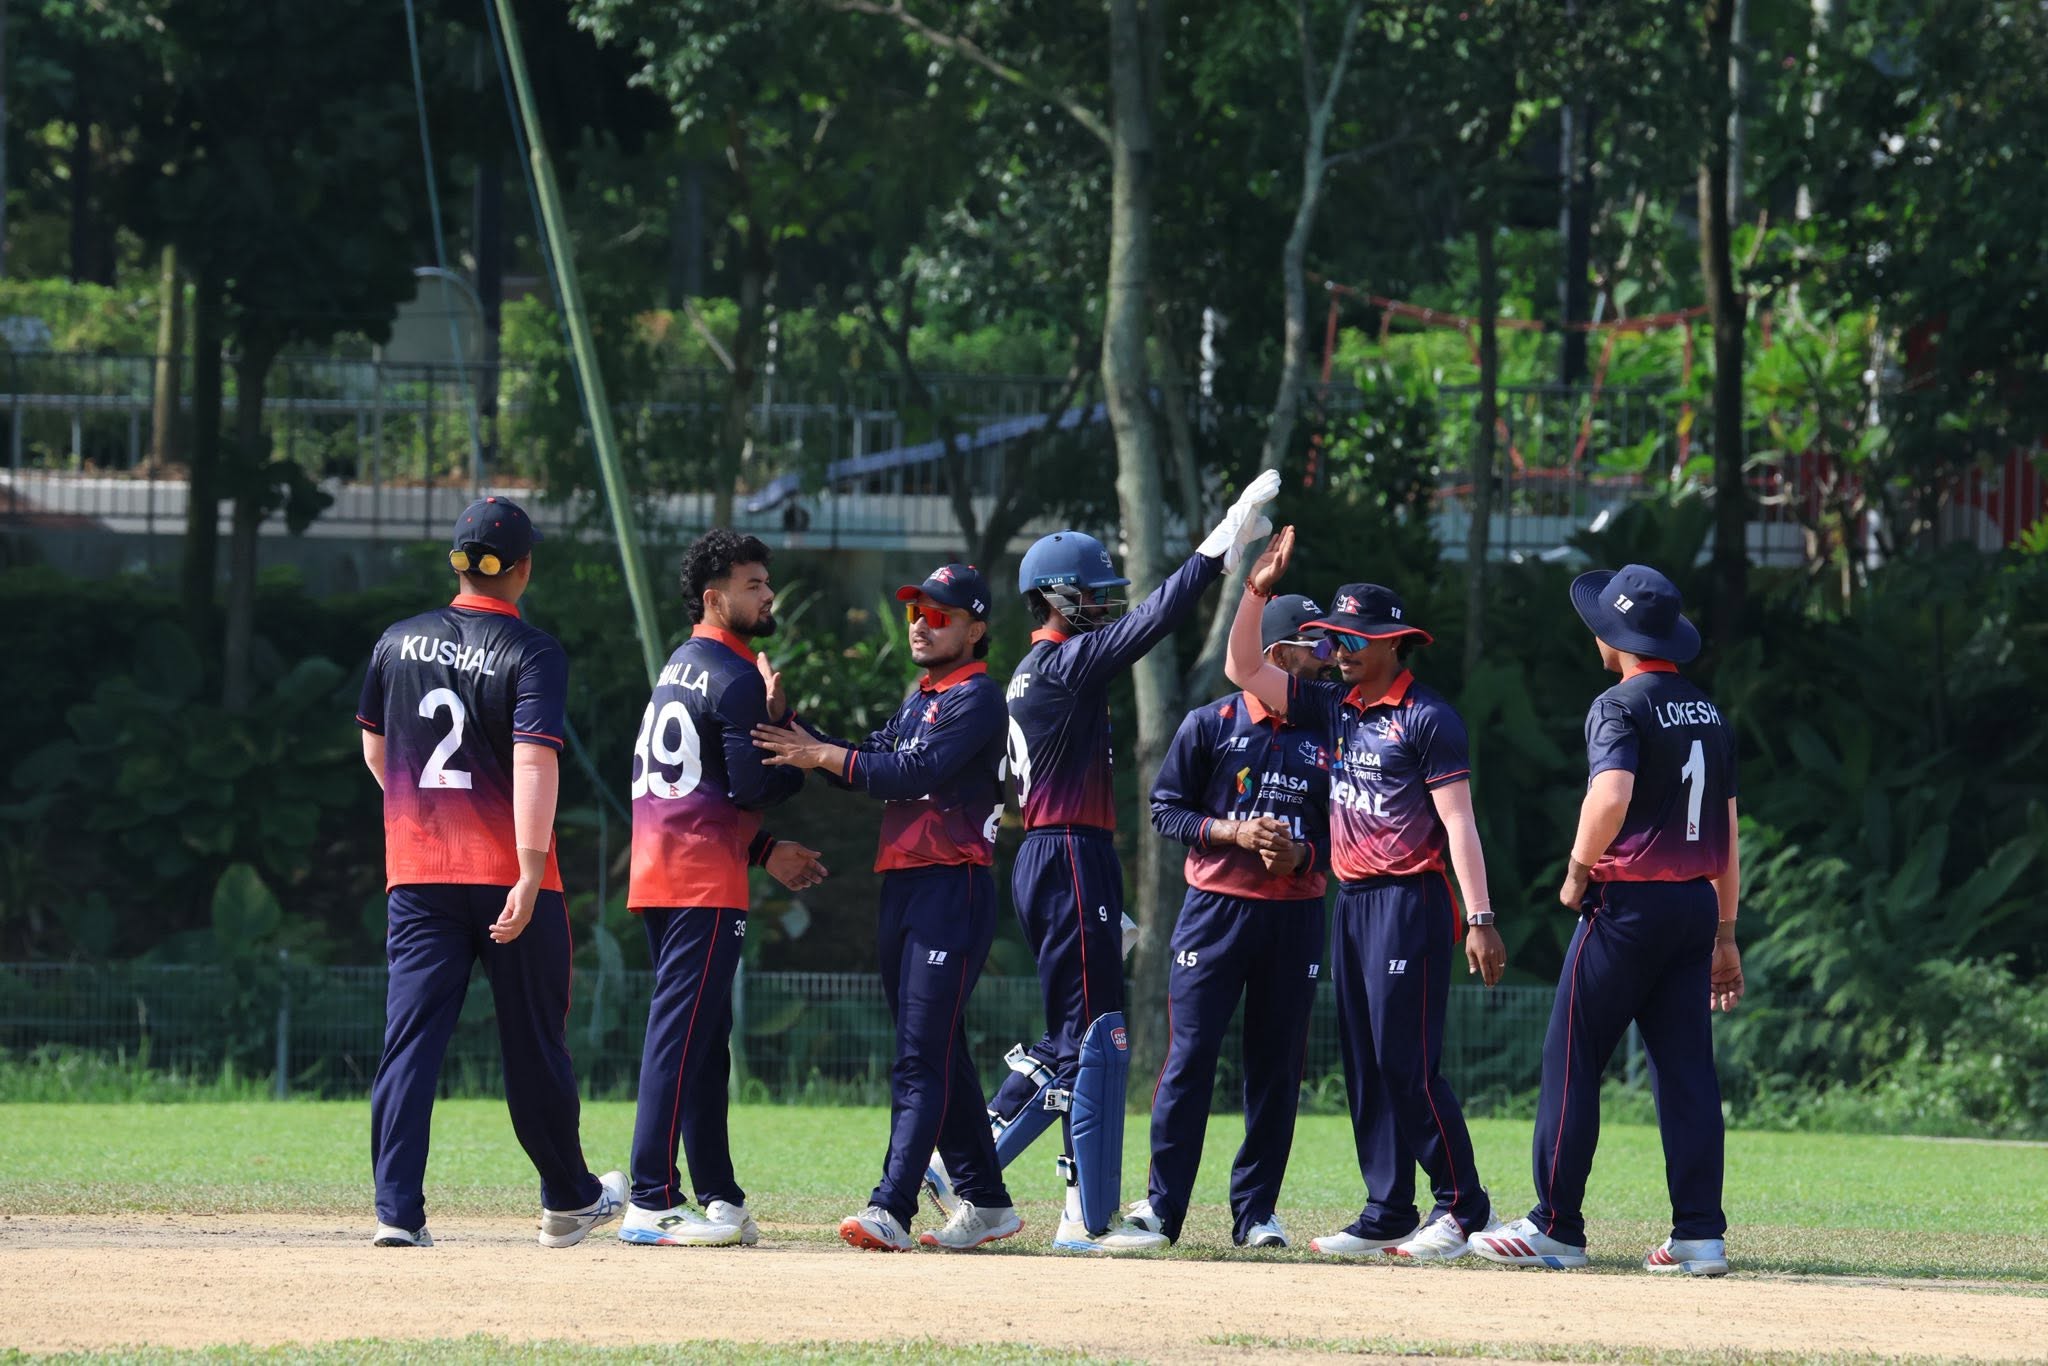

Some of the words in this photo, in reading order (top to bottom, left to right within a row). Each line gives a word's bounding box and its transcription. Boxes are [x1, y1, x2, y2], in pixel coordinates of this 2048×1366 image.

[1047, 577, 1064, 585] AIR
[400, 634, 496, 676] KUSHAL
[1655, 700, 1721, 728] LOKESH
[418, 687, 473, 789] 2
[1261, 770, 1309, 793] NAASA
[1681, 739, 1705, 841] 1
[1098, 905, 1108, 922] 9
[734, 919, 746, 937] 39
[1176, 950, 1198, 967] 45
